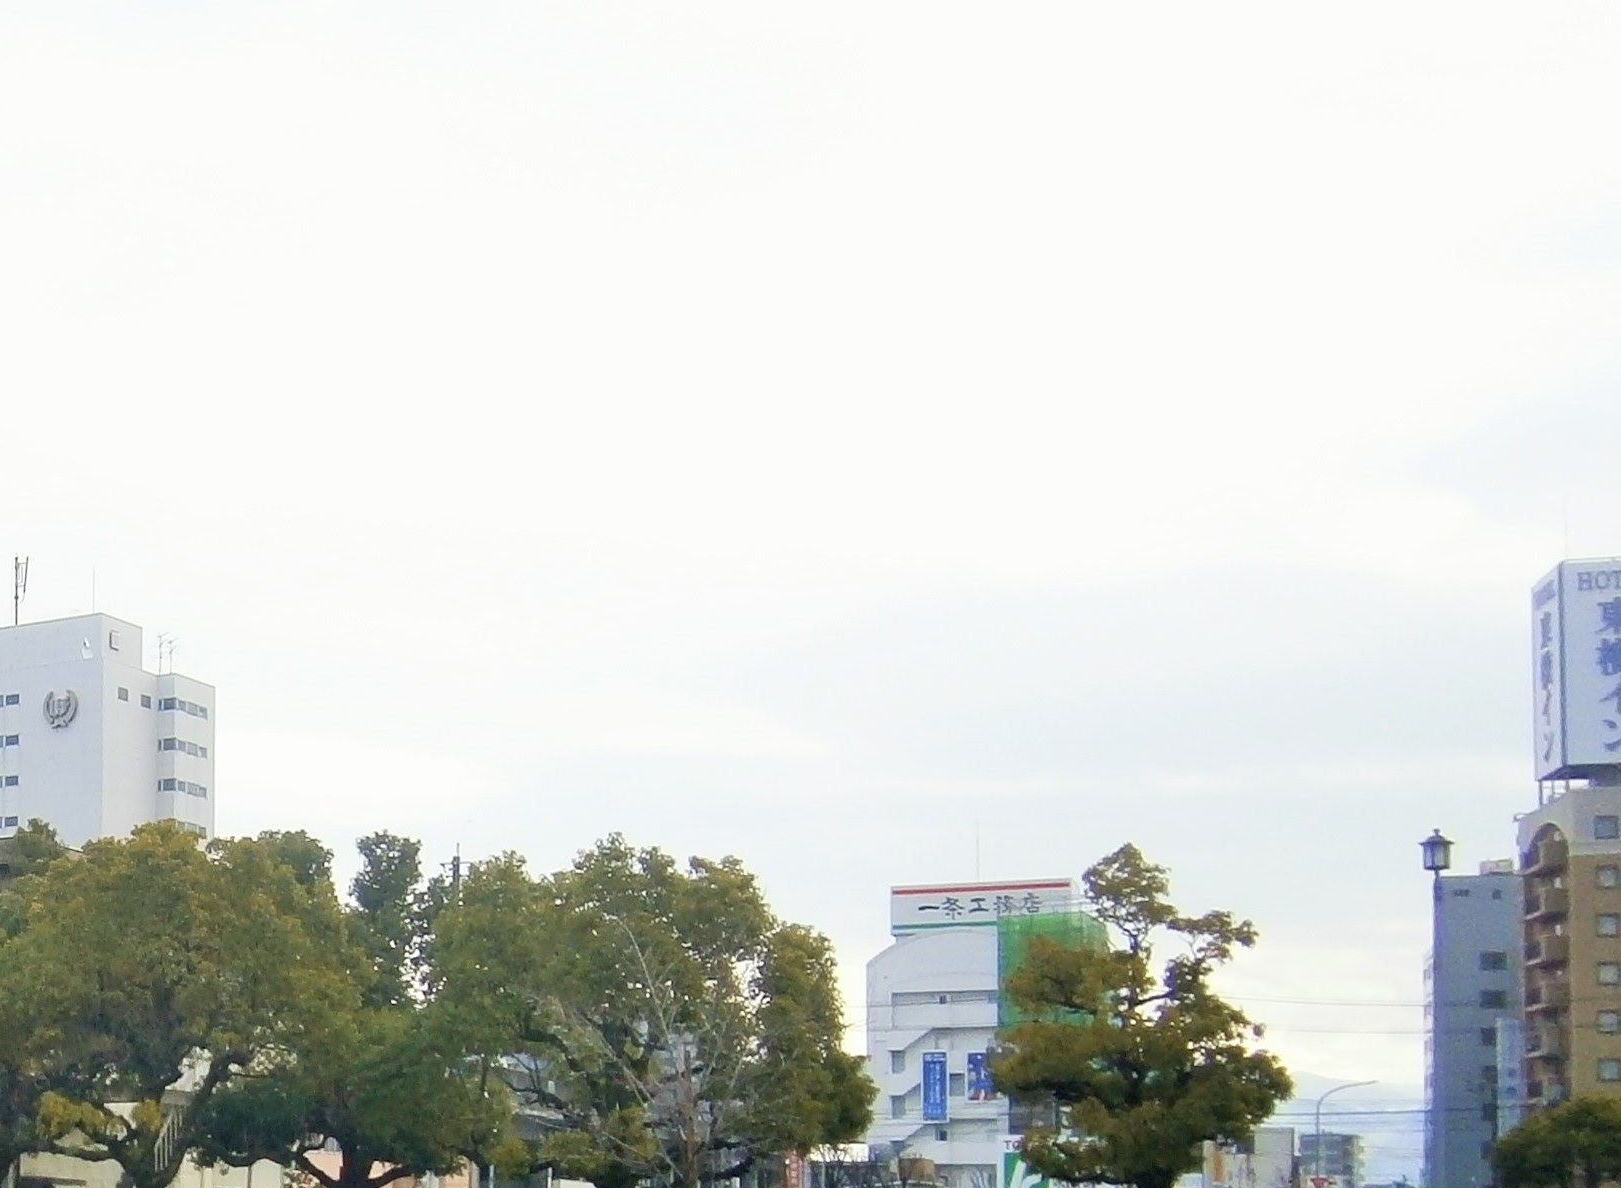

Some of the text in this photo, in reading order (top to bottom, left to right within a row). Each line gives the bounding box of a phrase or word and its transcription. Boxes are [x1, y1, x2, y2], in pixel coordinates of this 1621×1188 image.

[918, 892, 1042, 920] 一条工務店
